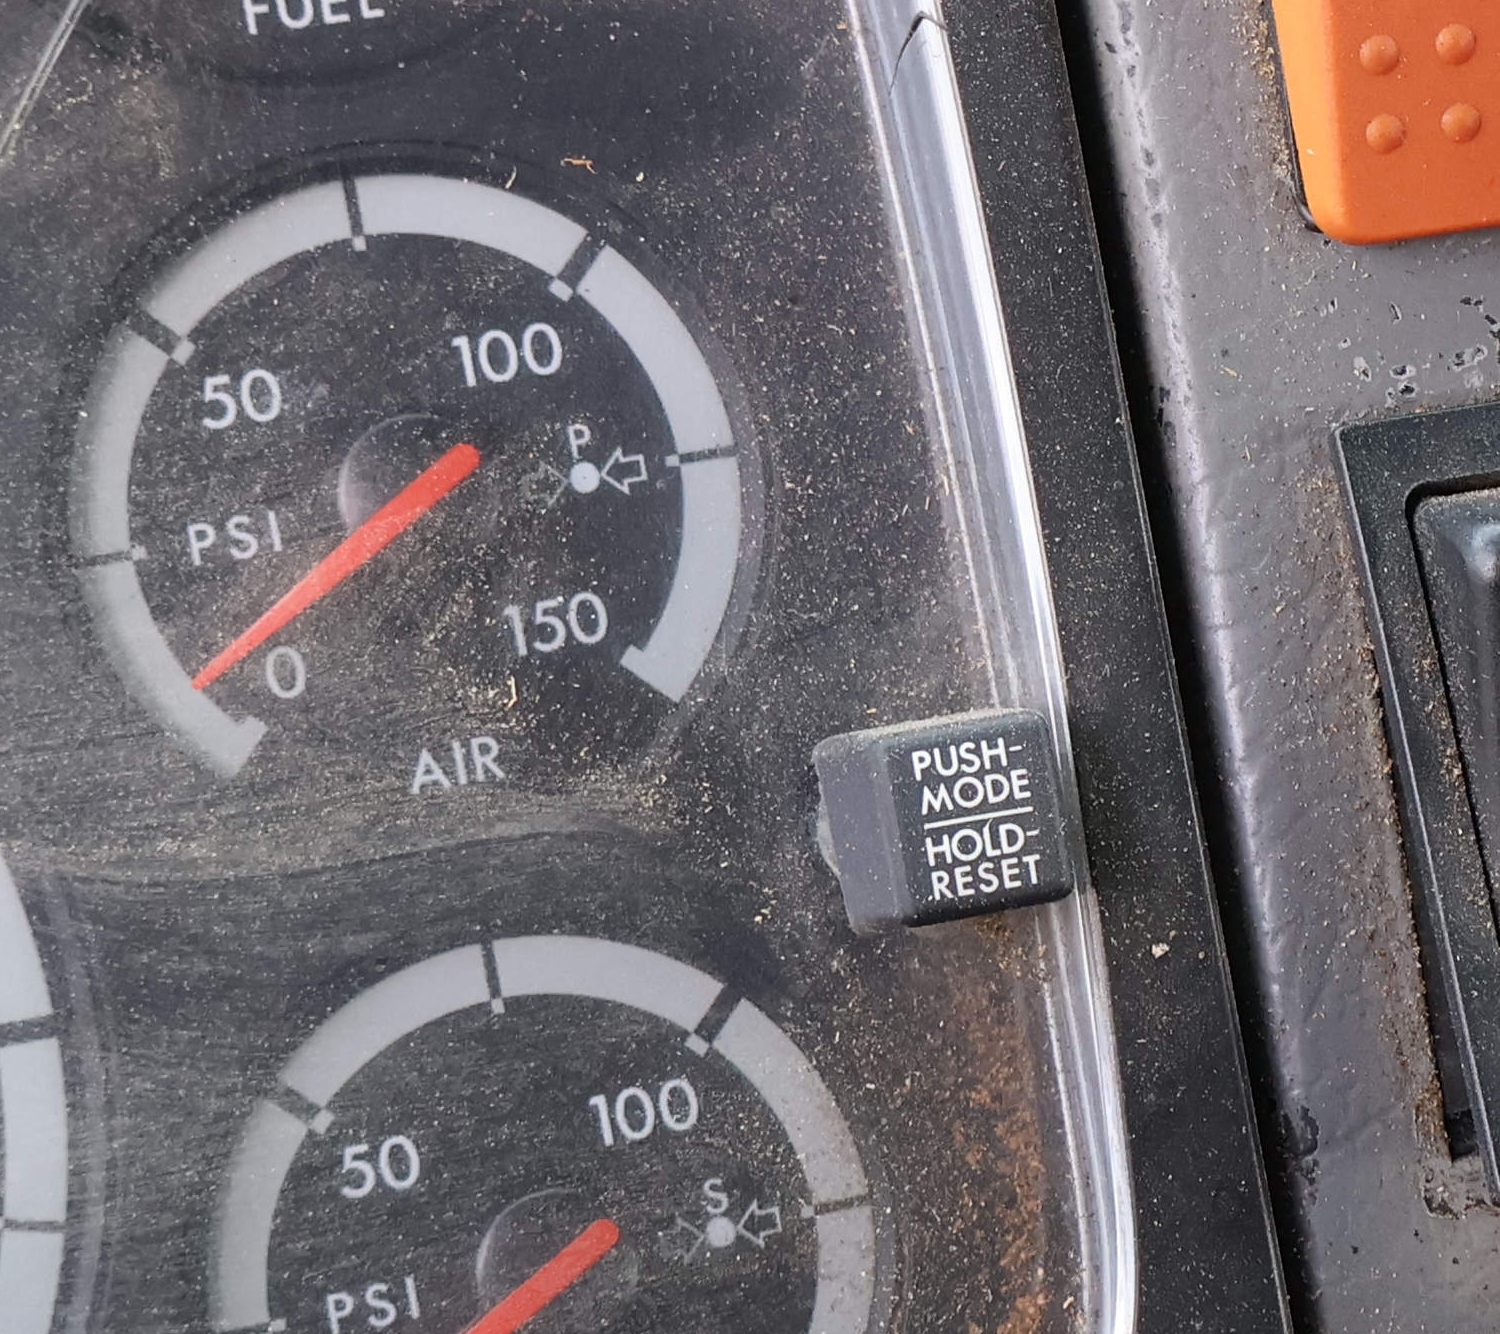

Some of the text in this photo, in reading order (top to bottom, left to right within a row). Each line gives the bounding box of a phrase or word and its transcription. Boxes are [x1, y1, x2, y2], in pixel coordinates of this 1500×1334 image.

[452, 322, 562, 387] 100
[201, 368, 282, 430] 50
[566, 424, 591, 457] P
[187, 510, 284, 565] PSI
[502, 592, 608, 657] 150
[265, 647, 306, 699] 0
[411, 736, 505, 794] AIR
[921, 769, 1031, 815] MODE
[931, 854, 1041, 900] RESET
[589, 1078, 698, 1147] 100
[340, 1135, 420, 1200] 50
[703, 1177, 729, 1212] S
